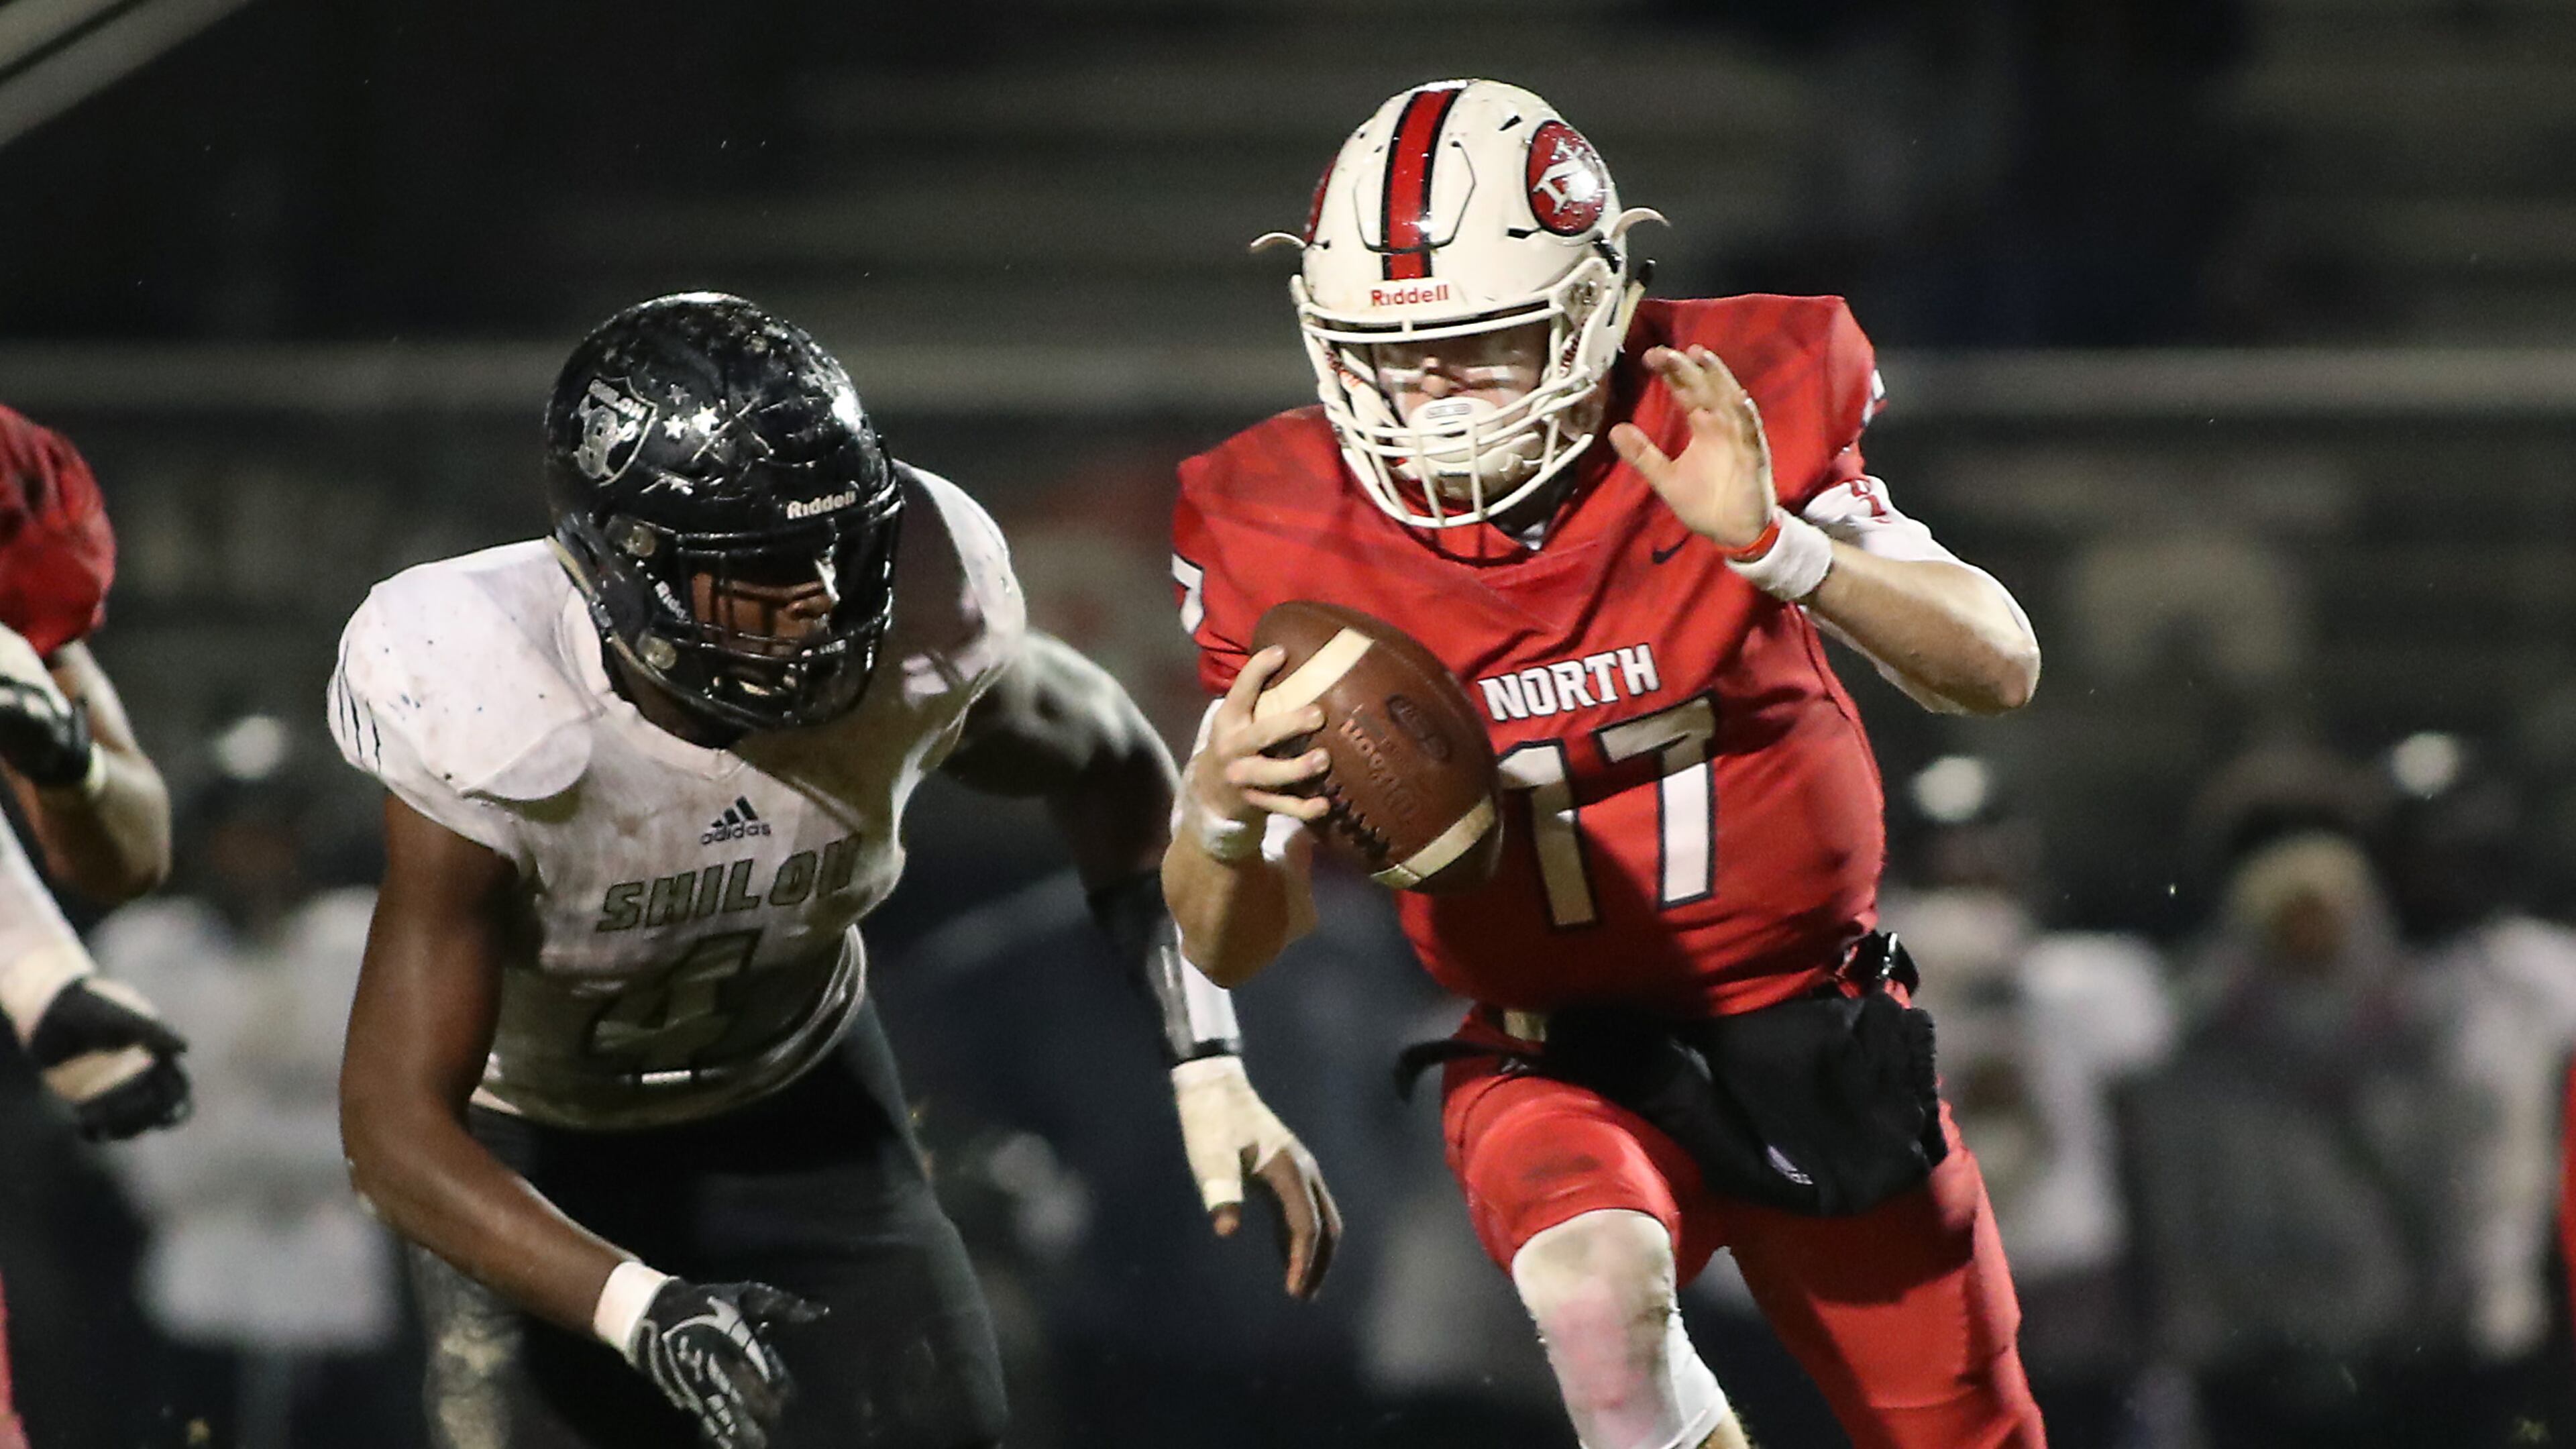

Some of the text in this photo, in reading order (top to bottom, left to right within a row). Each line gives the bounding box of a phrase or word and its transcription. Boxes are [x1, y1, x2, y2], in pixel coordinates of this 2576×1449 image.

[1371, 284, 1449, 306] Riddell
[786, 490, 856, 519] Riddell
[1478, 642, 1661, 722] NORTH
[700, 820, 772, 846] adidas
[1495, 688, 1717, 930] 17
[581, 926, 765, 1071] 4
